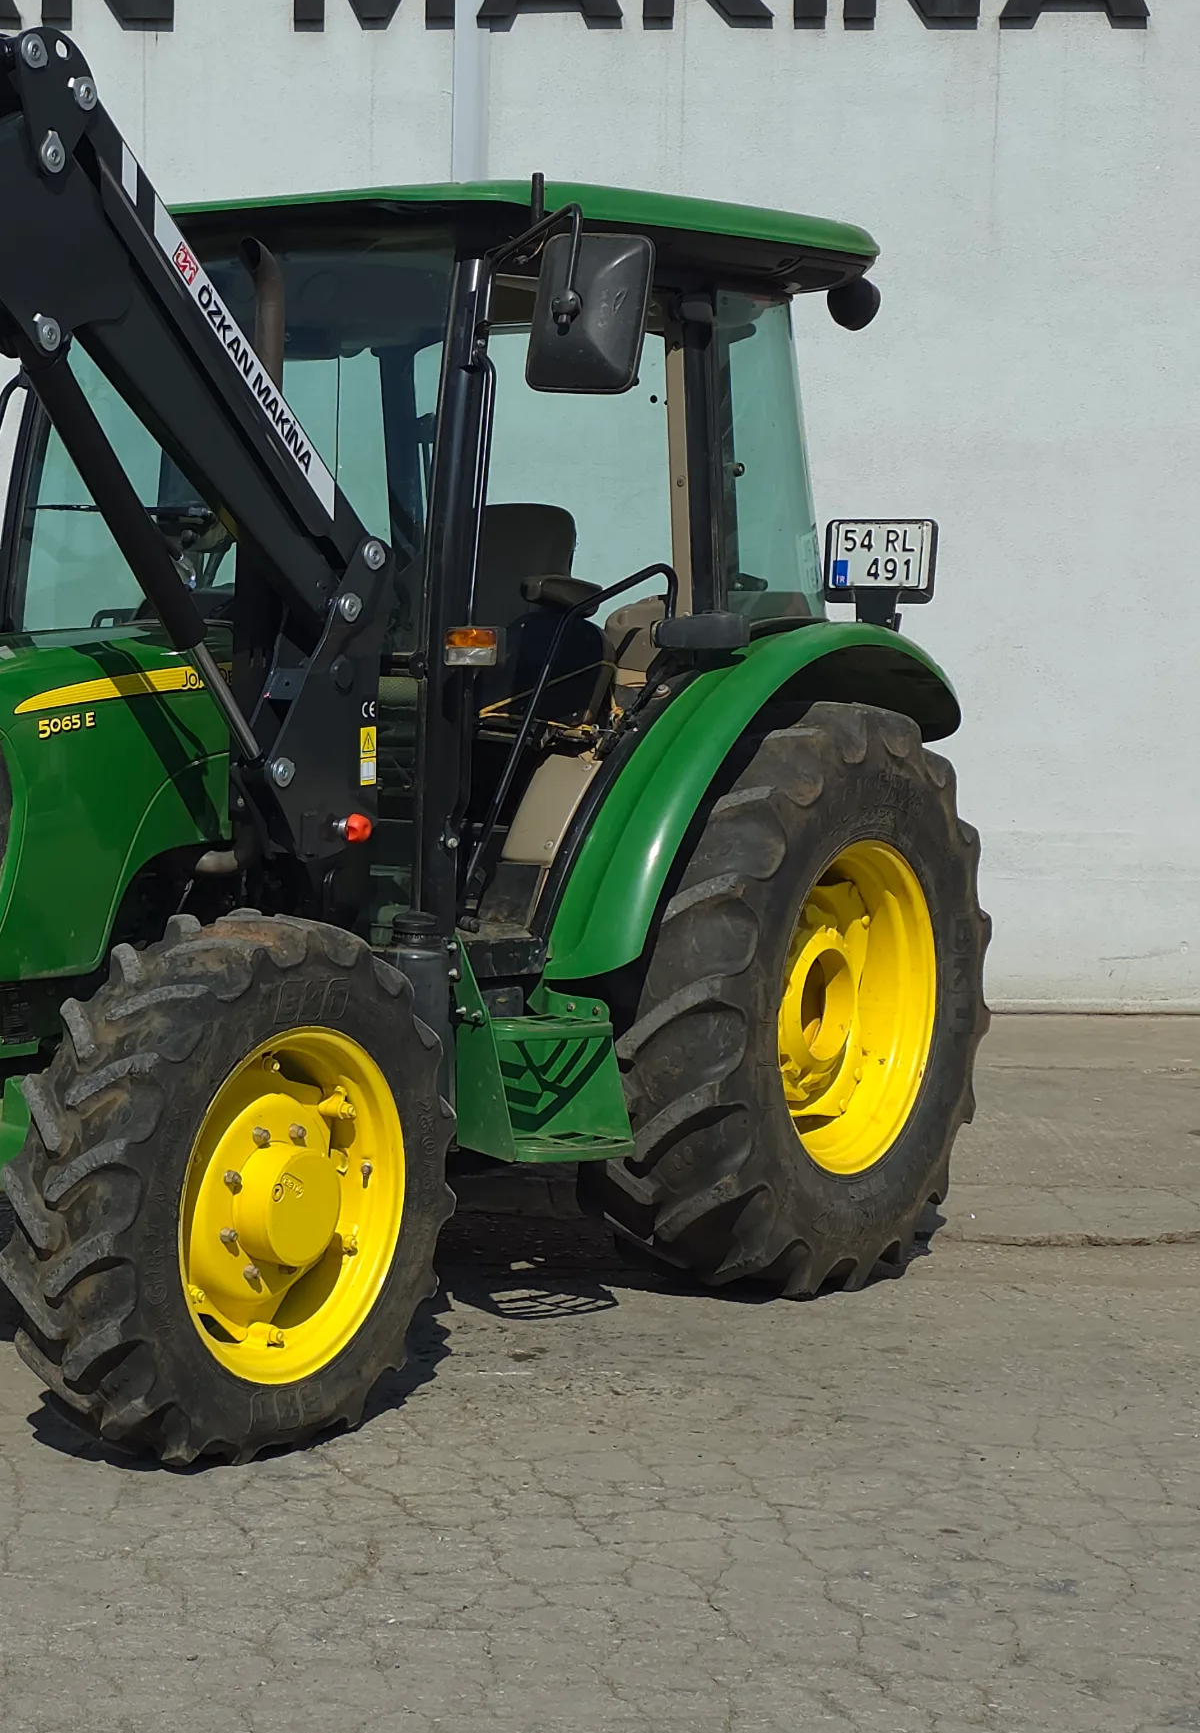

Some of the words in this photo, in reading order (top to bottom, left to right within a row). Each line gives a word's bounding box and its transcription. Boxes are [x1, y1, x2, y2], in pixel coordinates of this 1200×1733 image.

[198, 283, 254, 378] ÖZKAN
[252, 372, 312, 475] MAKİNA
[844, 529, 873, 552] 54
[885, 529, 915, 552] RL
[866, 557, 911, 581] 491
[38, 714, 81, 739] 5065
[85, 711, 96, 728] E
